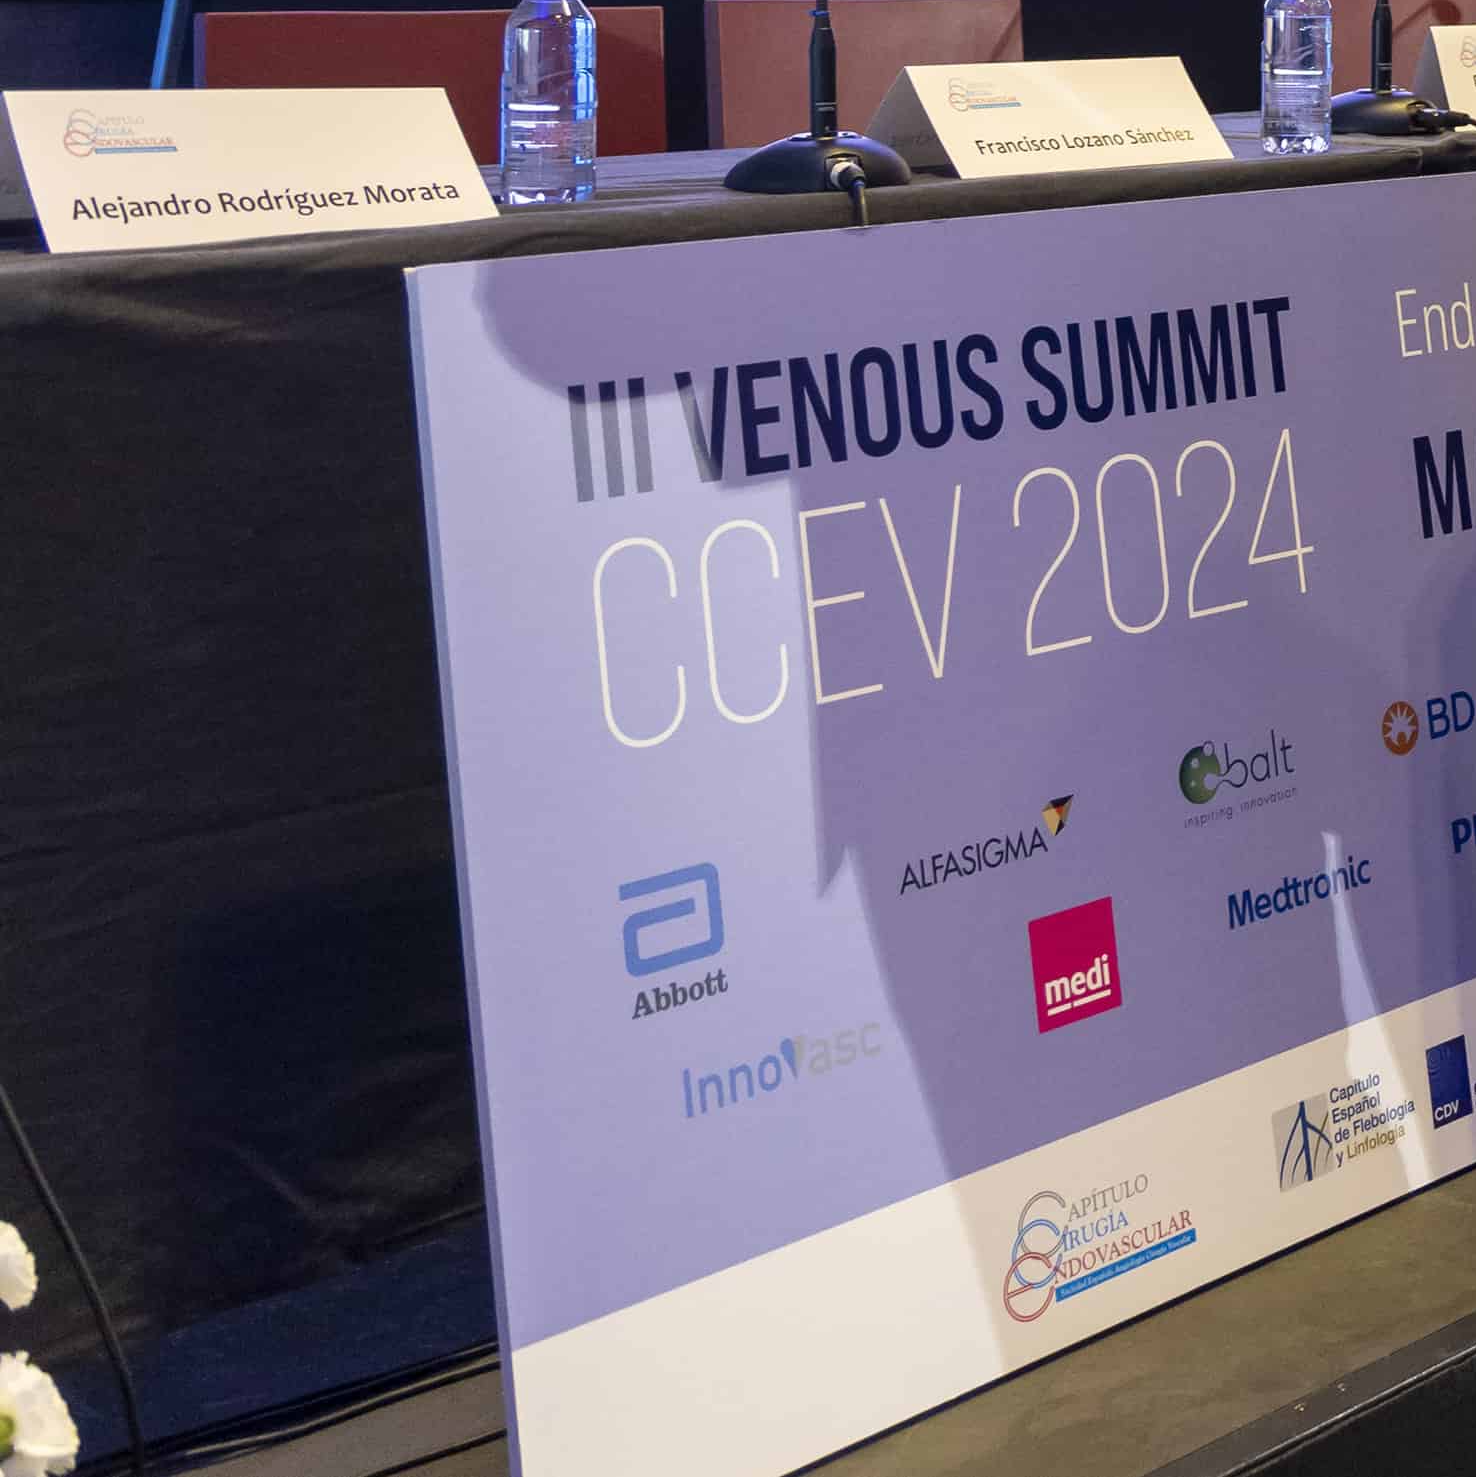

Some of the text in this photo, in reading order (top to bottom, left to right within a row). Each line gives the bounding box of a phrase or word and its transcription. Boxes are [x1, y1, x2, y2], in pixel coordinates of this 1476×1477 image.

[974, 126, 1195, 156] Francisco Lozano Sánchez
[71, 182, 461, 224] Alejandro Rodríguez Morata
[567, 296, 1291, 503] III VENOUS SUMMIT
[593, 428, 1315, 748] CCEV 2024
[1426, 690, 1475, 740] BD
[899, 826, 1049, 896] ALFASIGMA
[1226, 854, 1372, 930] Medtronic
[631, 968, 729, 1020] Abbott
[1044, 953, 1112, 1006] medi
[1331, 1091, 1381, 1125] Español
[1433, 1099, 1460, 1122] CDV
[1334, 1126, 1351, 1144] de
[1336, 1150, 1344, 1168] y
